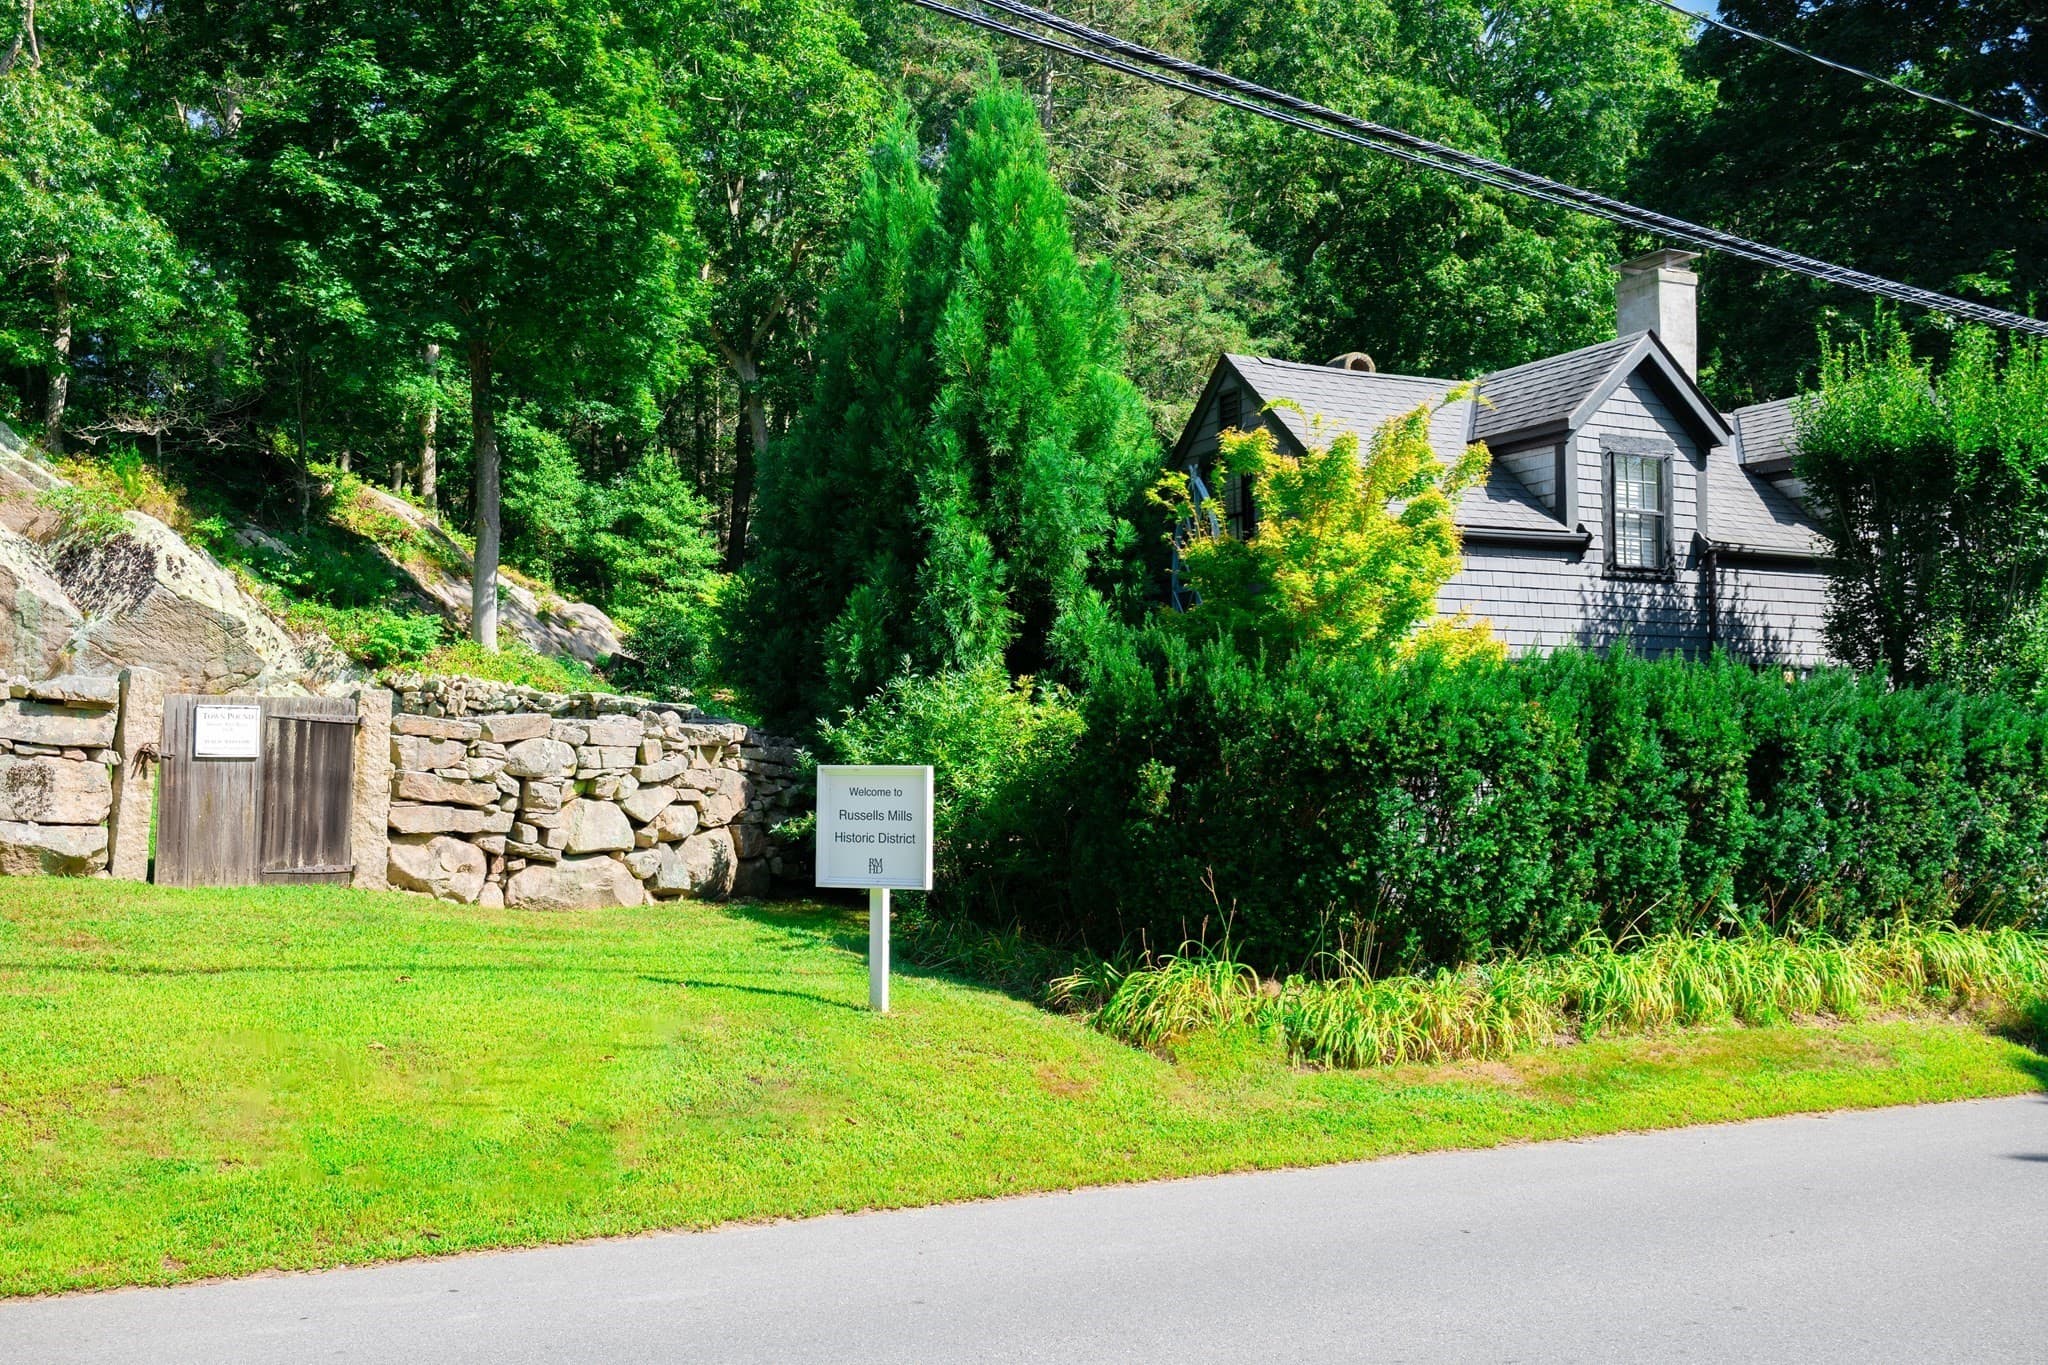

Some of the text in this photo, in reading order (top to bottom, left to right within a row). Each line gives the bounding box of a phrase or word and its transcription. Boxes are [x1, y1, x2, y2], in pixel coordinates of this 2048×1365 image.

[849, 787, 903, 797] Welcome to
[839, 809, 913, 822] Russells Mills
[834, 831, 916, 844] Historic District
[868, 858, 883, 866] RM
[868, 866, 883, 874] HD
